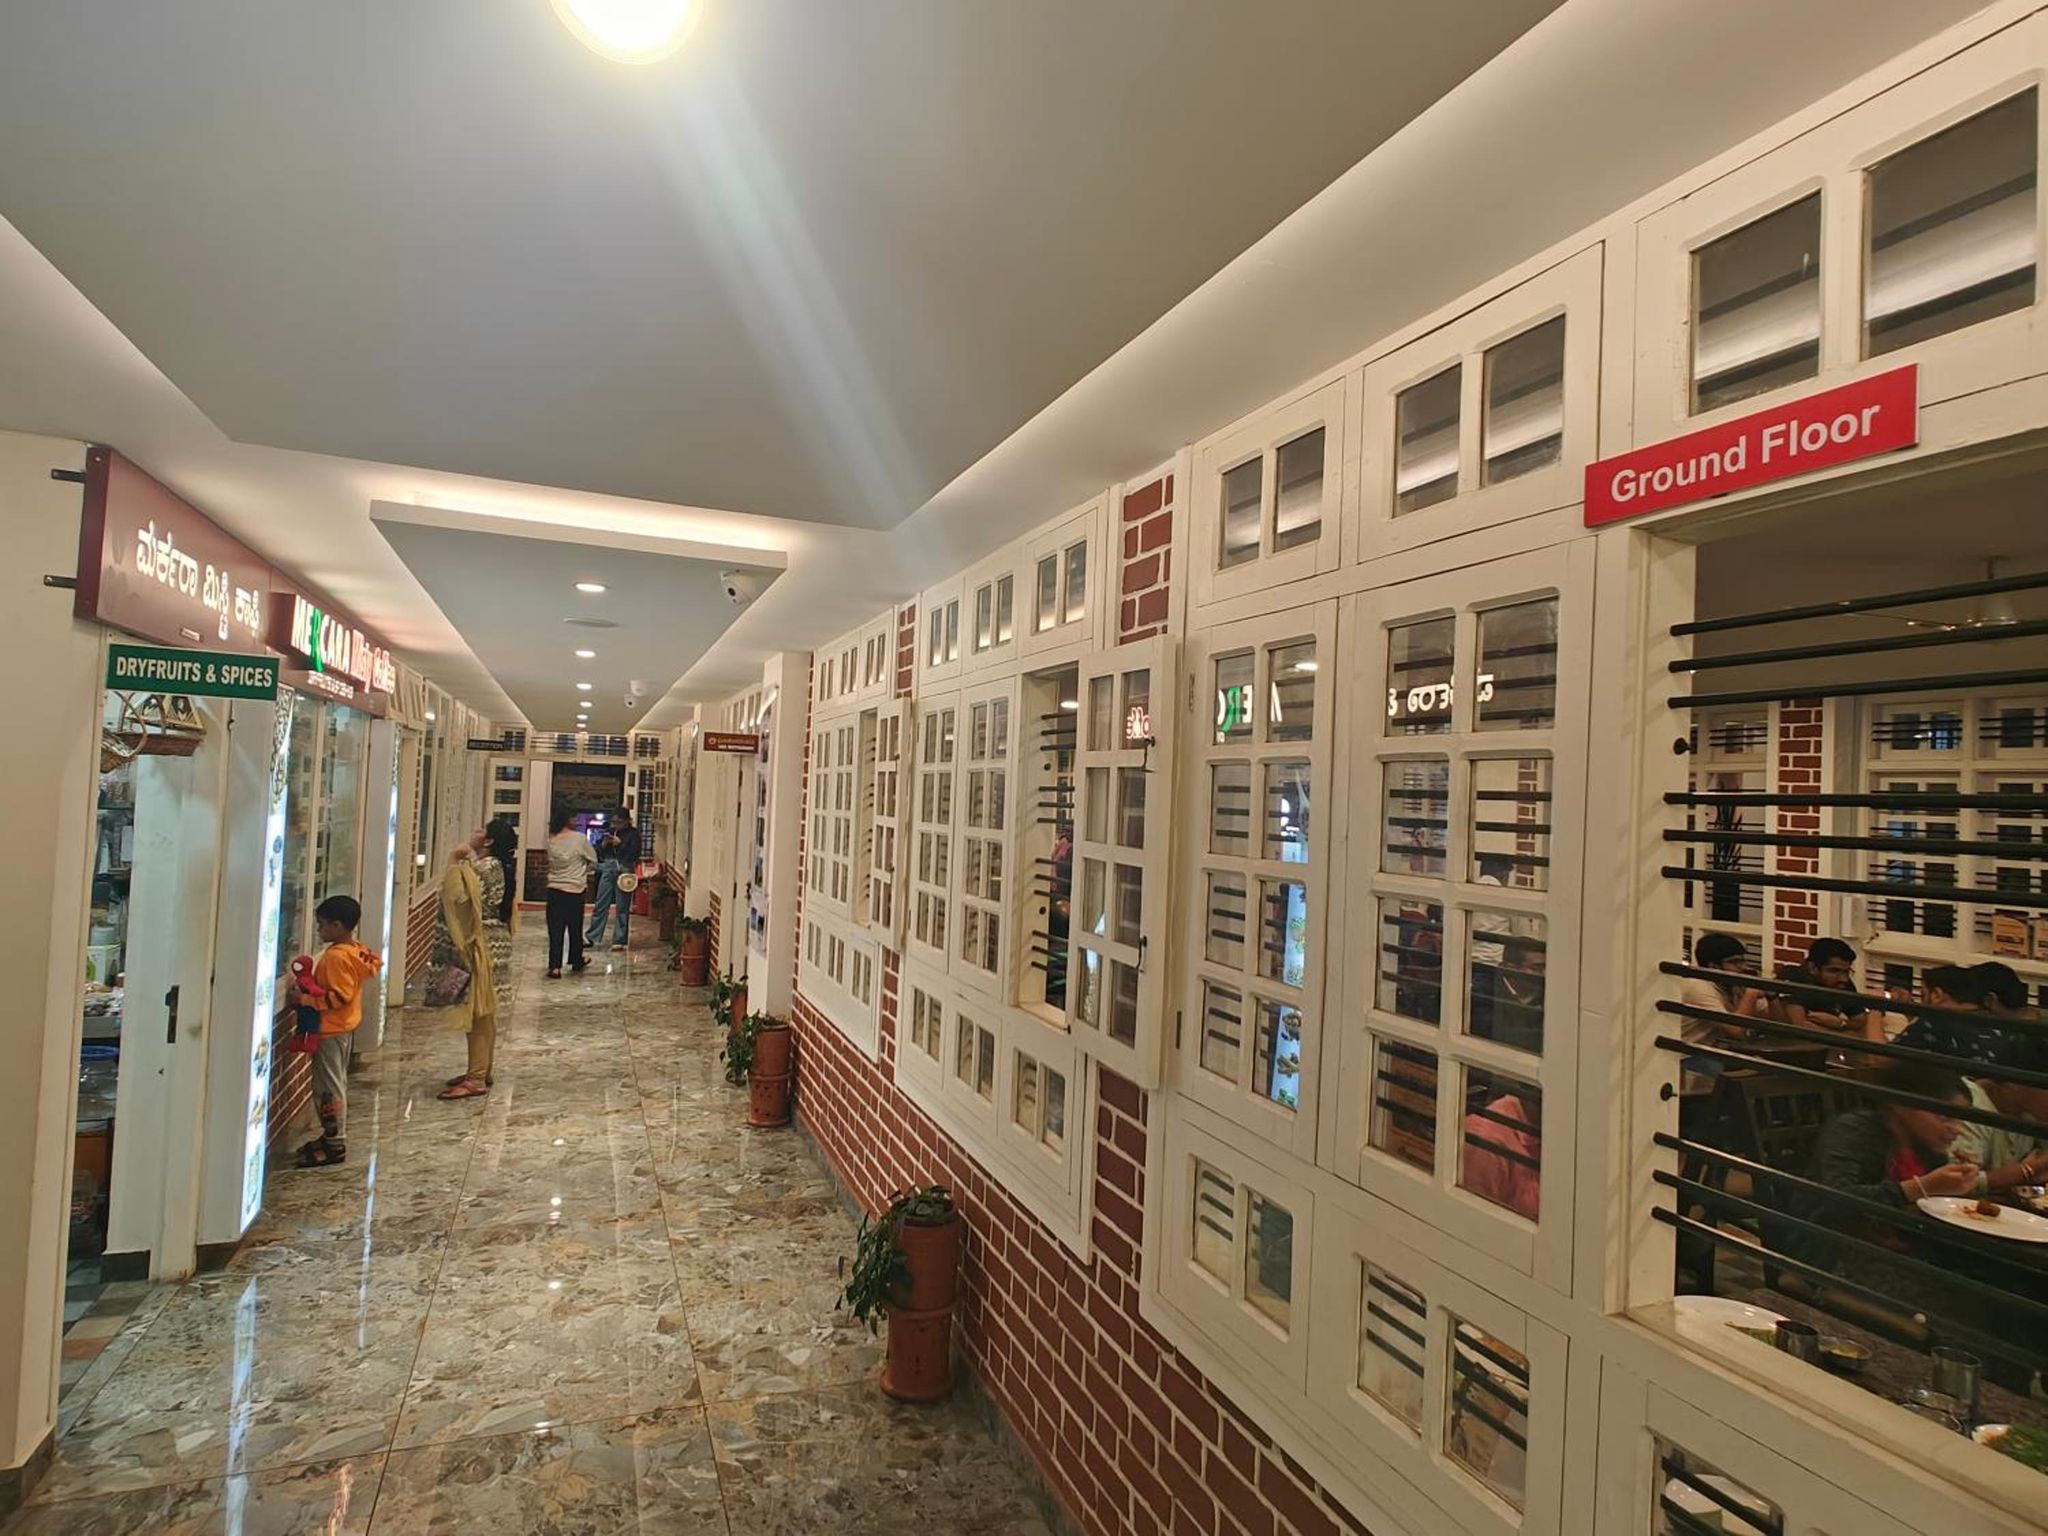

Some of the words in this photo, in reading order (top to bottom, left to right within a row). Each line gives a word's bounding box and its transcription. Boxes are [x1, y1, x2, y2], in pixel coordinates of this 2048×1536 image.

[1610, 435, 1747, 503] Ground
[1761, 402, 1882, 464] Floor
[116, 655, 201, 683] DRYFRUITS
[205, 663, 217, 684] &
[221, 664, 273, 688] SPICES
[290, 594, 351, 674] MERCARA
